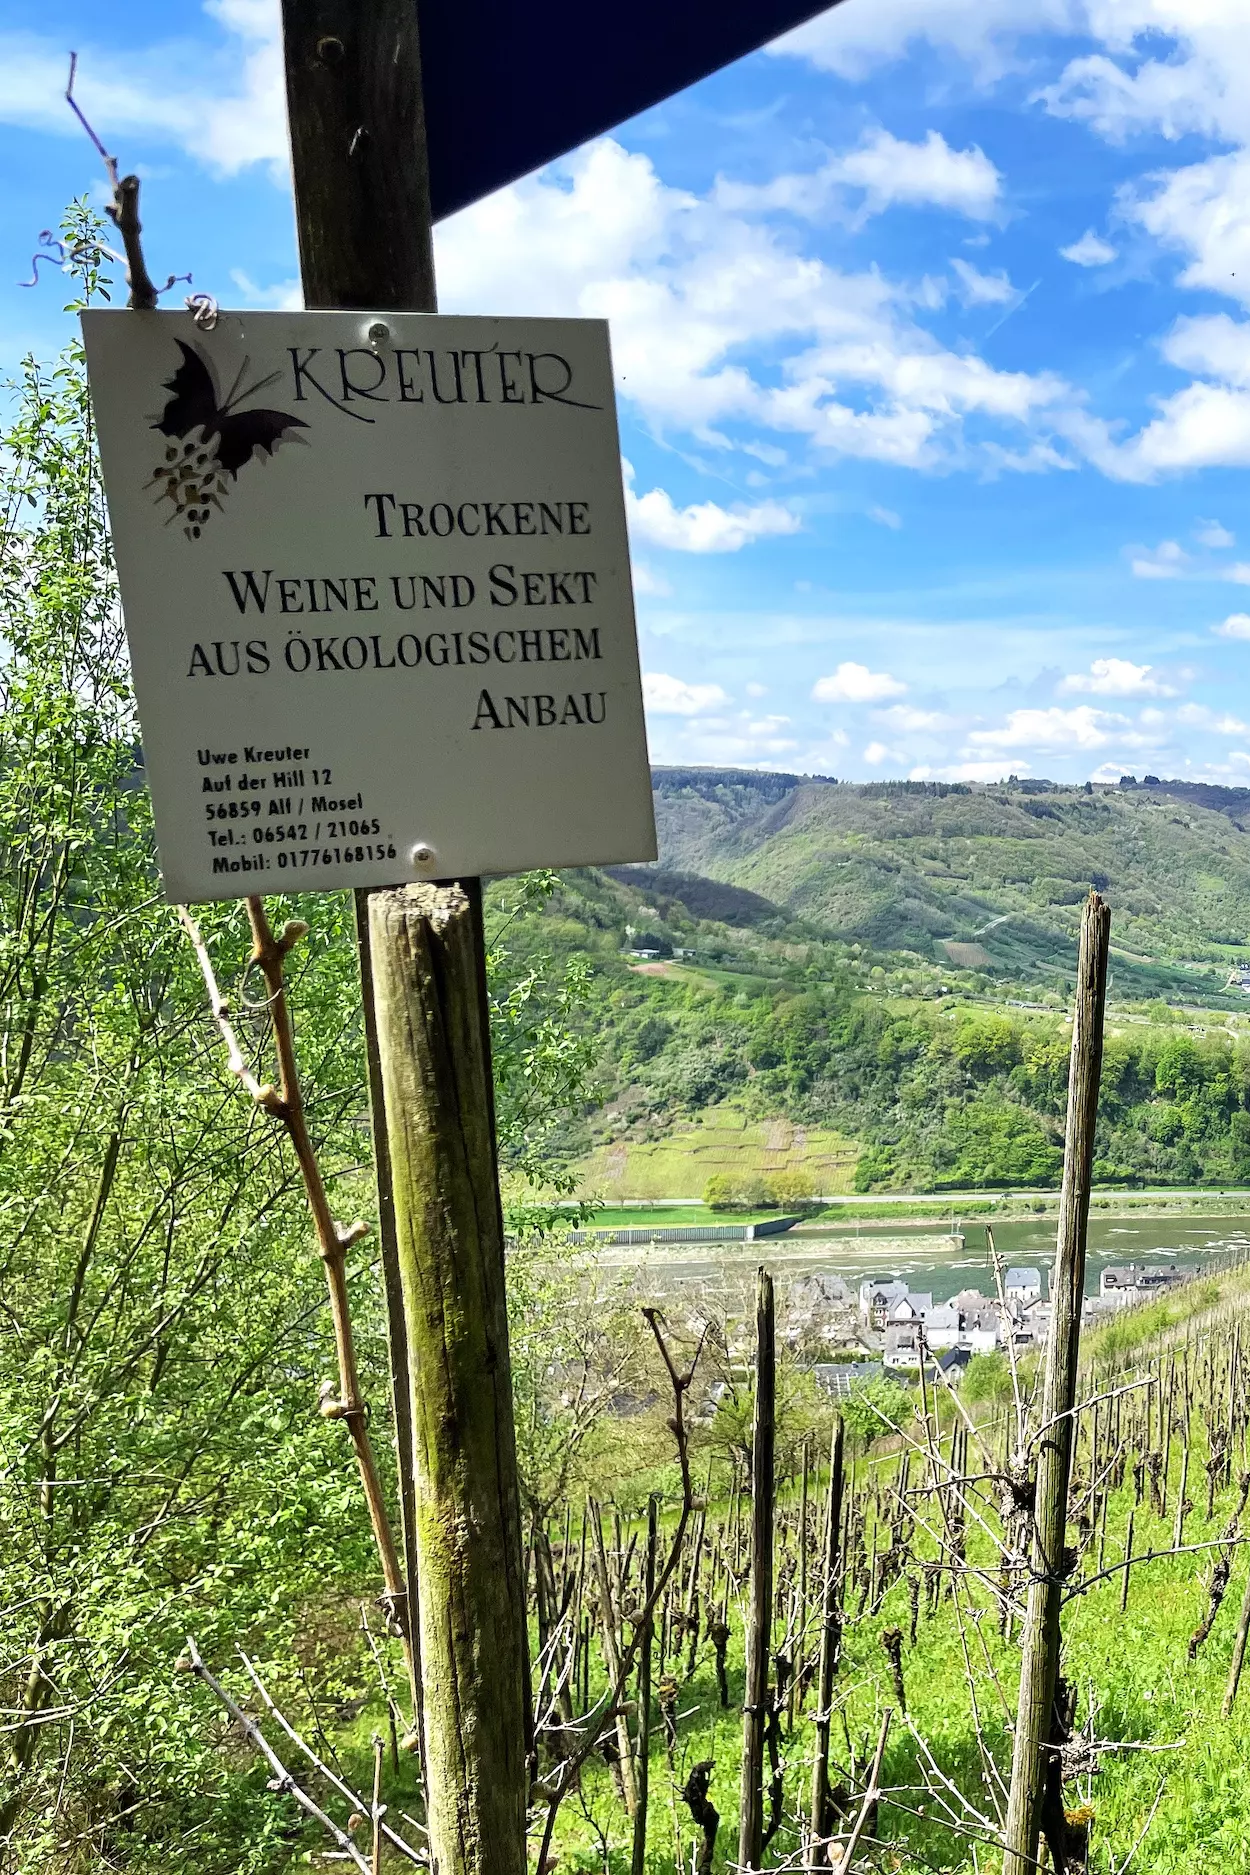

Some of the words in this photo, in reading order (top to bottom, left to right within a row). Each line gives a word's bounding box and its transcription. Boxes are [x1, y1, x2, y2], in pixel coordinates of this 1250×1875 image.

[287, 342, 604, 423] KREUTER
[388, 574, 476, 610] UND
[186, 641, 271, 677] AUS
[284, 627, 603, 673] ÖKOLOGISCHEM
[197, 749, 238, 766] Uwe
[243, 746, 310, 763] Kreuter
[202, 774, 231, 793] Auf
[237, 773, 267, 791] der
[272, 769, 305, 788] Hill
[312, 768, 333, 786] 12
[205, 800, 262, 821] 56859
[268, 797, 292, 816] Alf
[298, 798, 304, 816] /
[311, 792, 363, 813] Mosel
[207, 829, 247, 847] Tel.:
[252, 824, 308, 844] 06542
[315, 822, 321, 841] /
[327, 818, 380, 838] 21065
[212, 853, 270, 874] Mobil:
[277, 843, 396, 869] 01776168156
